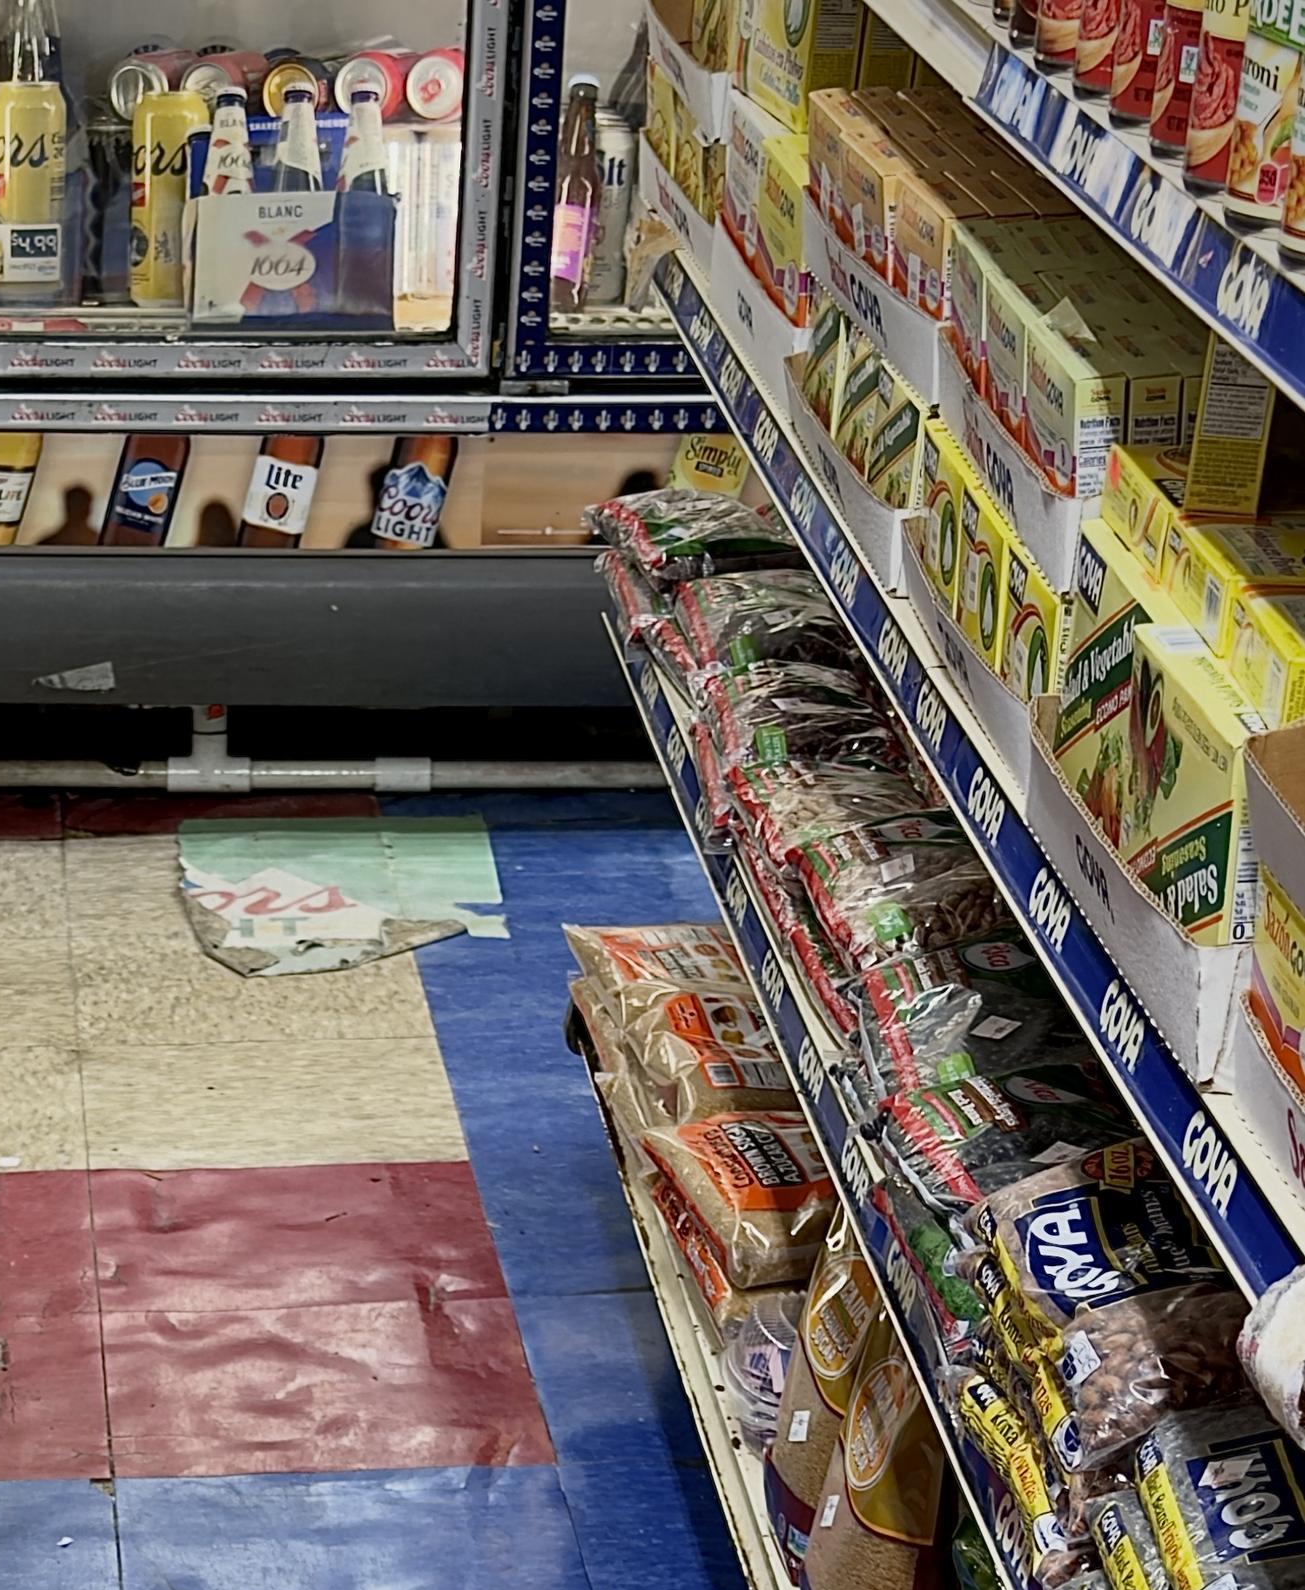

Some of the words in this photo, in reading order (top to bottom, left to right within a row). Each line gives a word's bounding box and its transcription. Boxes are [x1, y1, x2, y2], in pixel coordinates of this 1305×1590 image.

[486, 27, 496, 58] LIGHT
[481, 119, 492, 149] LIGHT
[258, 205, 304, 219] BLANC
[478, 210, 487, 240] LIGHT
[250, 254, 307, 276] 1664
[473, 298, 482, 329] LIGHT
[850, 273, 886, 334] GOYA
[128, 358, 158, 369] LIGHT
[377, 358, 407, 370] LIGHT
[128, 412, 158, 422] LIGHT
[377, 413, 407, 424] LIGHT
[265, 463, 303, 490] Lite
[686, 436, 742, 476] Simply
[0, 488, 22, 503] LIFE
[377, 484, 440, 527] Coors
[375, 516, 433, 543] LIGHT
[830, 539, 859, 608] GOYA
[1077, 541, 1107, 606] GOYA
[877, 617, 909, 686] GOYA
[1089, 615, 1135, 683] Vegetabl
[915, 678, 946, 753] GOYA
[967, 766, 1005, 847] GOYA
[1161, 834, 1207, 877] Seasoning
[725, 868, 747, 927] GOYA
[1028, 867, 1072, 954] GOYA
[1177, 863, 1218, 921] Salad
[760, 948, 785, 1013] GOYA
[1098, 977, 1146, 1075] GOYA
[798, 1034, 825, 1104] GOYA
[840, 1134, 869, 1205] GOYA
[1182, 1110, 1239, 1221] GOYA
[885, 1238, 918, 1318] GOYA
[1039, 1202, 1120, 1298] GOYA
[996, 1490, 1035, 1588] GOYA
[1102, 1508, 1124, 1546] GOYA
